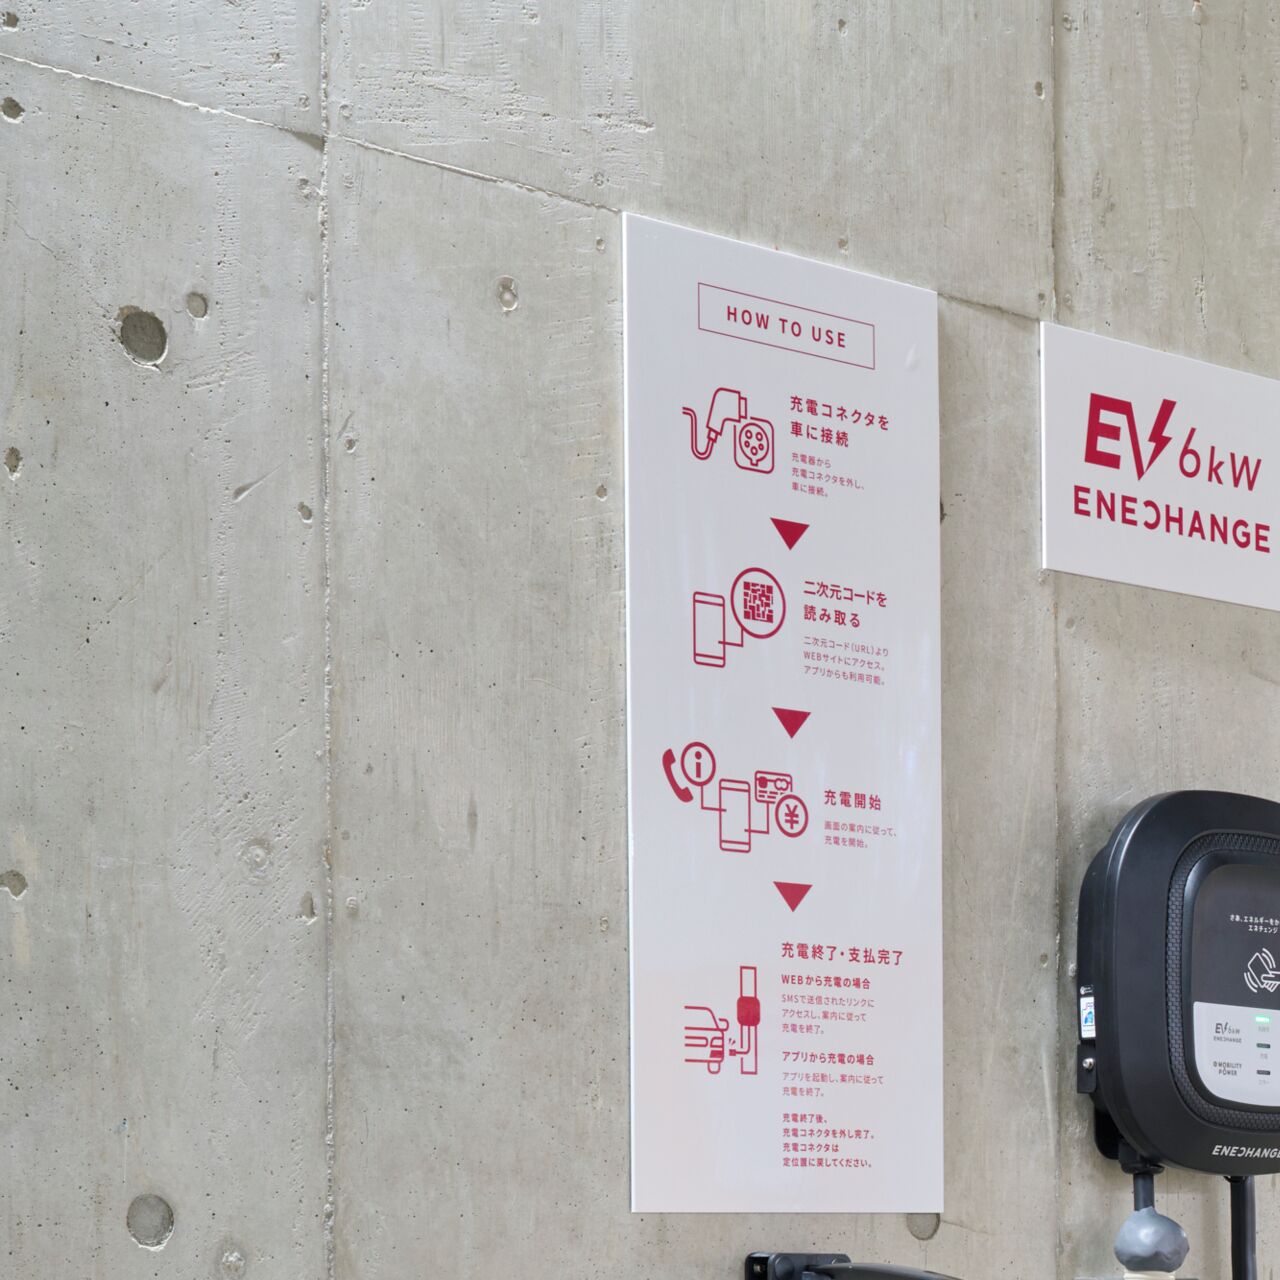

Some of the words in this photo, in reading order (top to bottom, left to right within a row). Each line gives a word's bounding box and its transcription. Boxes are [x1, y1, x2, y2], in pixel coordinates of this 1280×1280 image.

[727, 305, 769, 330] HOW
[779, 318, 802, 337] TO
[812, 325, 845, 348] USE
[790, 395, 889, 431] 充電コネクタを
[790, 421, 849, 448] 車に接続
[1084, 392, 1177, 481] EV
[1179, 427, 1262, 491] 6kW
[791, 452, 832, 469] 充電器から
[791, 467, 864, 490] 充電コネクタを外し、
[791, 481, 828, 497] 車に接続。
[803, 580, 887, 608] 二次元コードを
[803, 604, 860, 628] 読み取る
[803, 650, 885, 671] WEBサイトにアクセス。
[803, 665, 885, 686] アプリからも利用可能。
[824, 789, 881, 811] 充電開始
[824, 820, 897, 837] 画面の案内に従って、
[824, 835, 868, 849] 充電を開始。
[781, 942, 903, 966] 充電終了・支払完了
[781, 974, 871, 990] WEBから充電の場合
[781, 993, 875, 1008] SMSで送信されたリンクに
[782, 1008, 867, 1022] アクセスし、案内に従って
[782, 1023, 824, 1035] 充電を終了。
[782, 1050, 875, 1066] アプリから充電の場合
[782, 1086, 825, 1098] 充電を終了。
[782, 1113, 828, 1124] 充電終了後、
[782, 1127, 874, 1140] 充電コネクタを外し完了。
[782, 1142, 840, 1153] 充電コネクタは
[782, 1156, 872, 1168] 定位置に戻してください。
